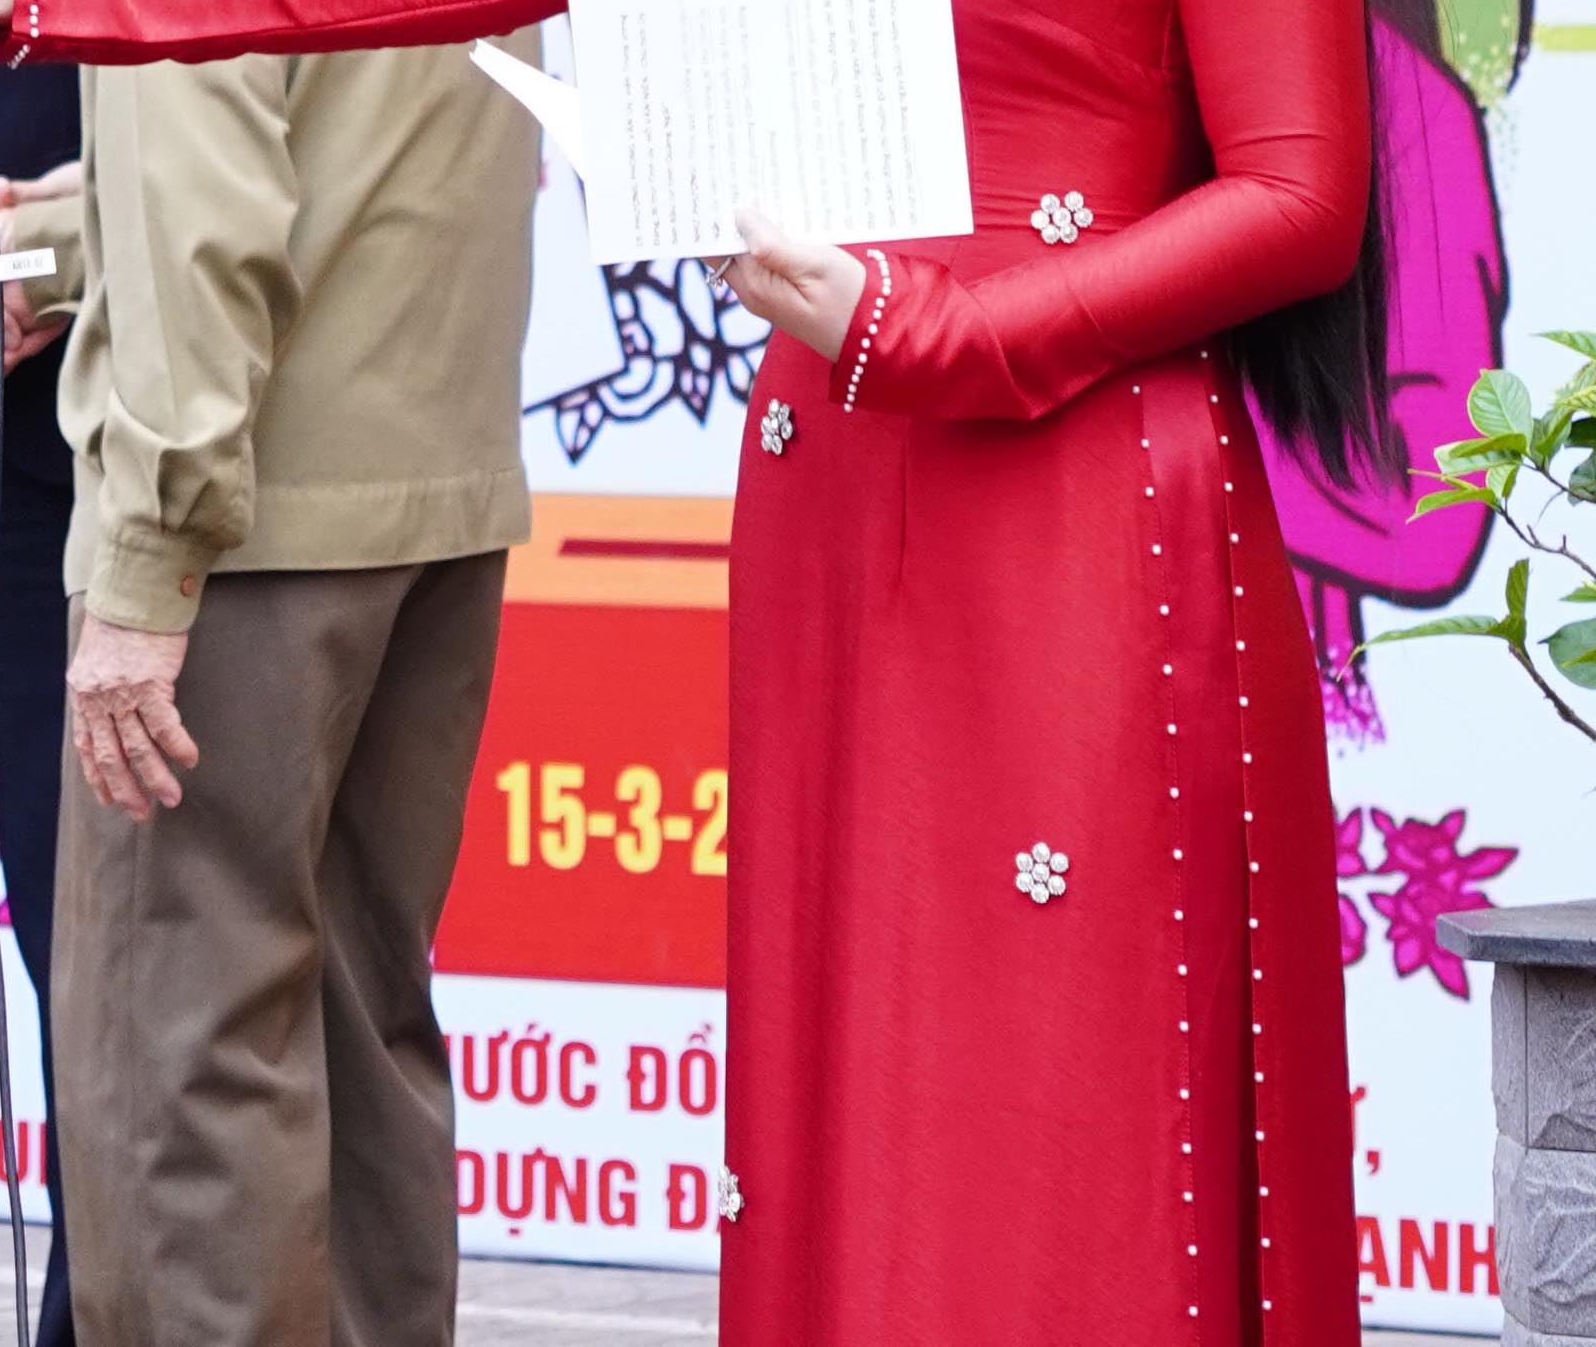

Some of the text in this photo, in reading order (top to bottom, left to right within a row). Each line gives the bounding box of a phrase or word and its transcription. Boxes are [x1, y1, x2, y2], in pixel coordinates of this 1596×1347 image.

[443, 1024, 597, 1109] ƯỚC
[455, 1148, 636, 1236] DỰNG
[667, 1164, 722, 1232] Đ
